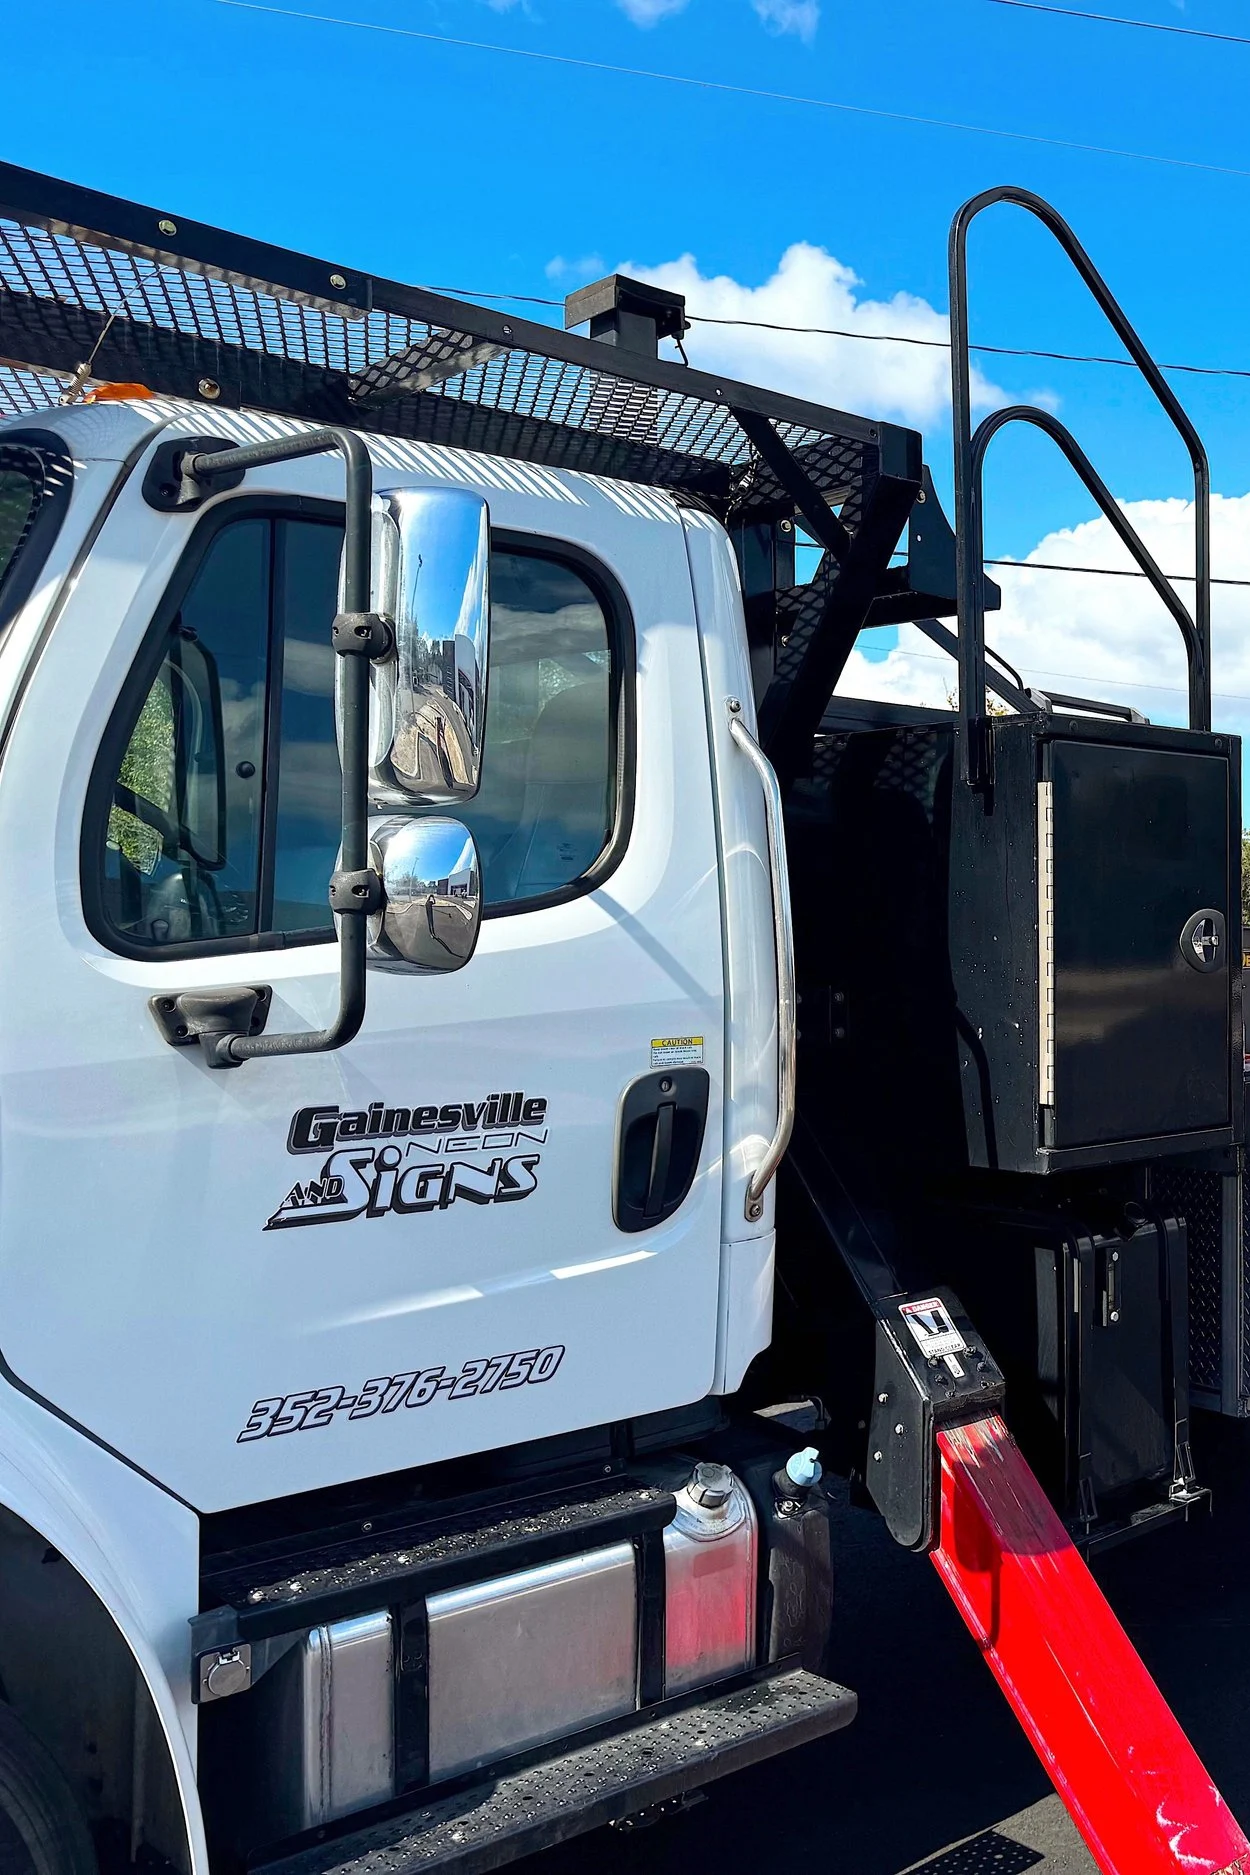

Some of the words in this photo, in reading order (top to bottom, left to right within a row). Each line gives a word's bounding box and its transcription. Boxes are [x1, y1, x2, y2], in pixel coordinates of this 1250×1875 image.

[661, 1038, 693, 1047] CAUTION
[287, 1091, 548, 1155] Gainesville
[405, 1129, 549, 1158] NEON
[280, 1176, 345, 1208] AND
[236, 1345, 565, 1443] 352-376-2750
